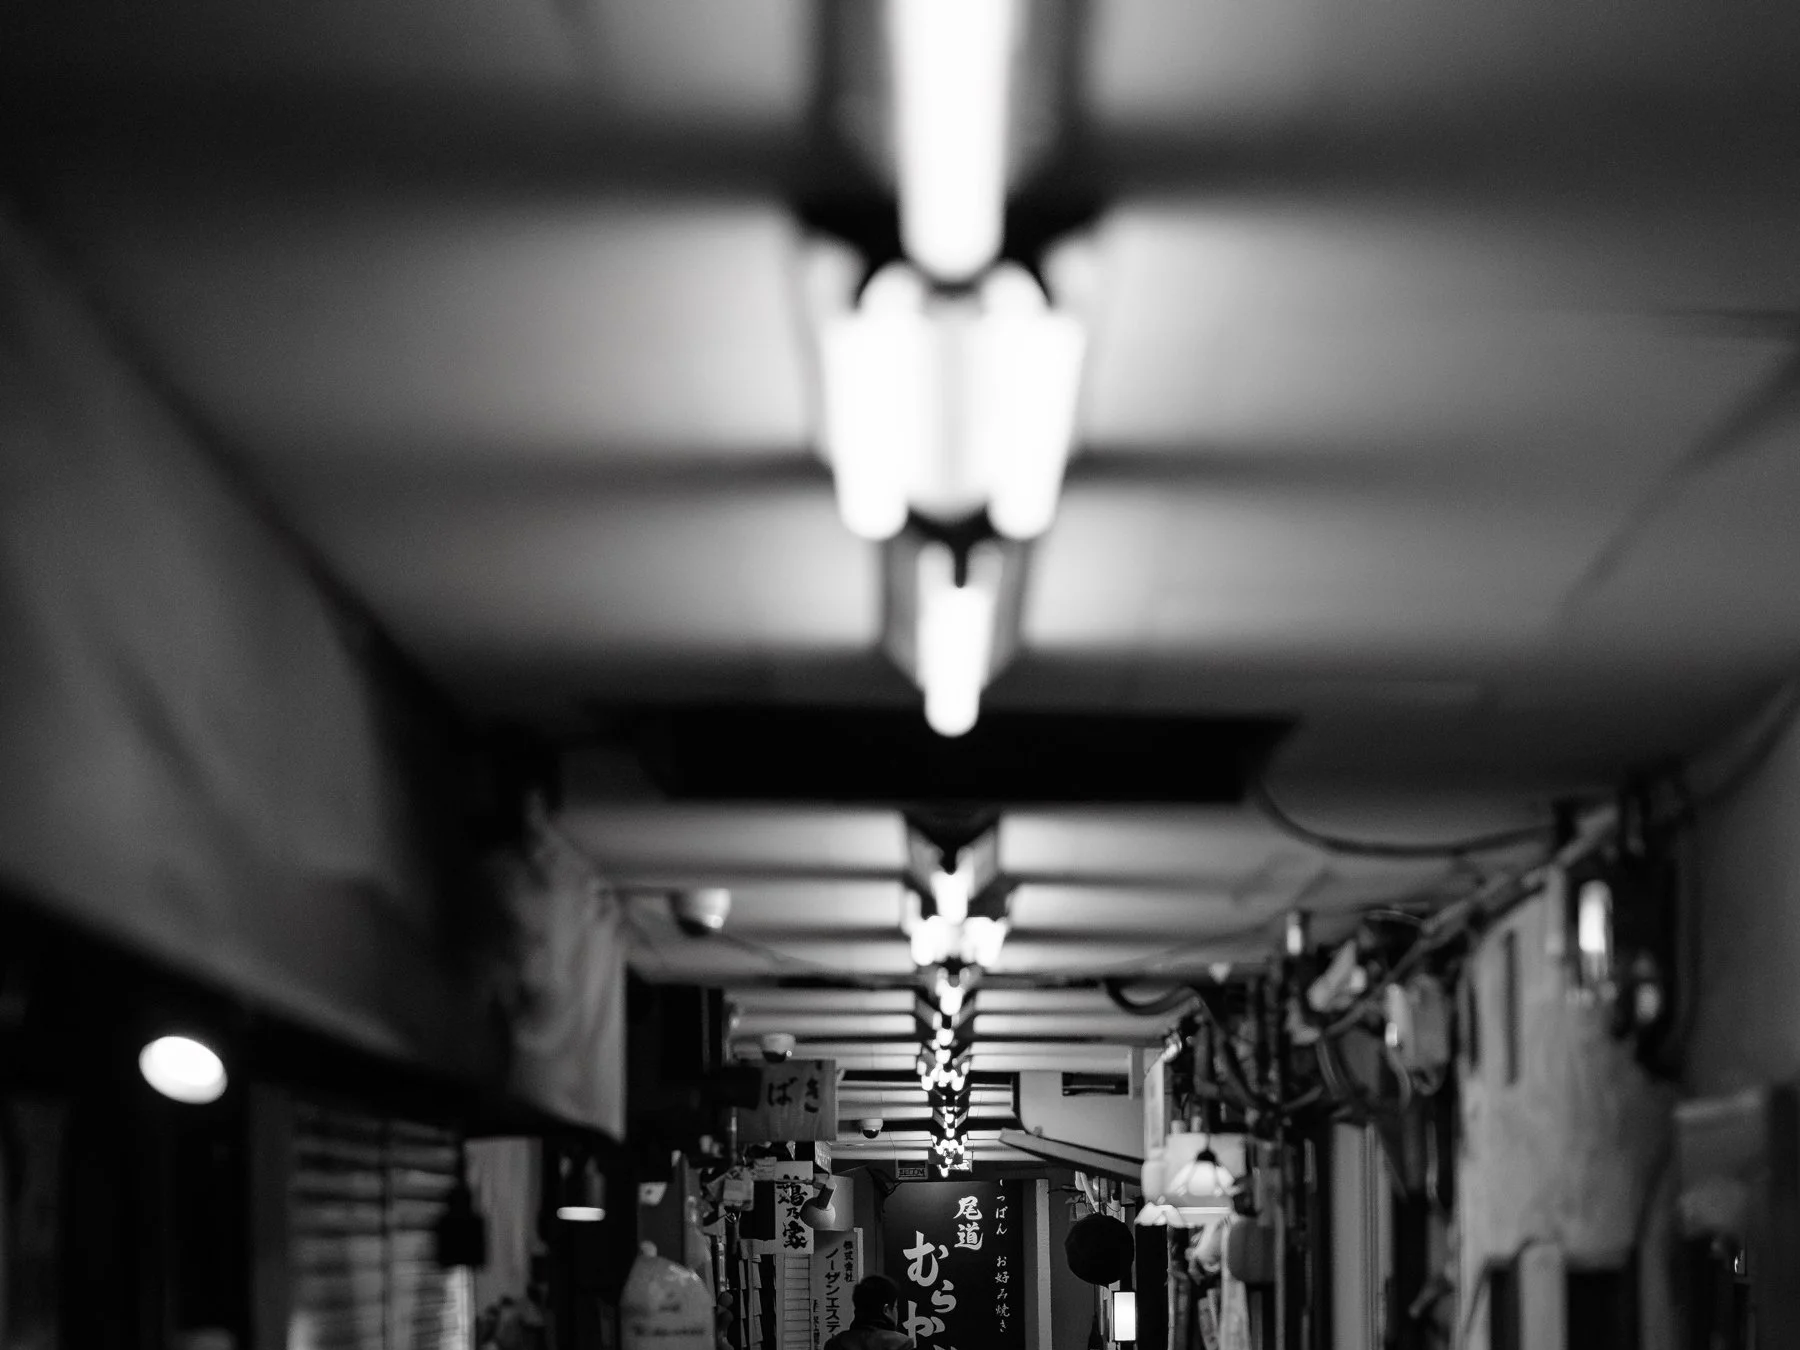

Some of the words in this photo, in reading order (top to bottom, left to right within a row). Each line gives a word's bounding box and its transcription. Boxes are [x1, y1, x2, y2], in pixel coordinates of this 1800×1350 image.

[953, 1196, 984, 1251] 尾道
[825, 1248, 841, 1340] ノーザンエステ
[995, 1255, 1011, 1333] お好み焼き
